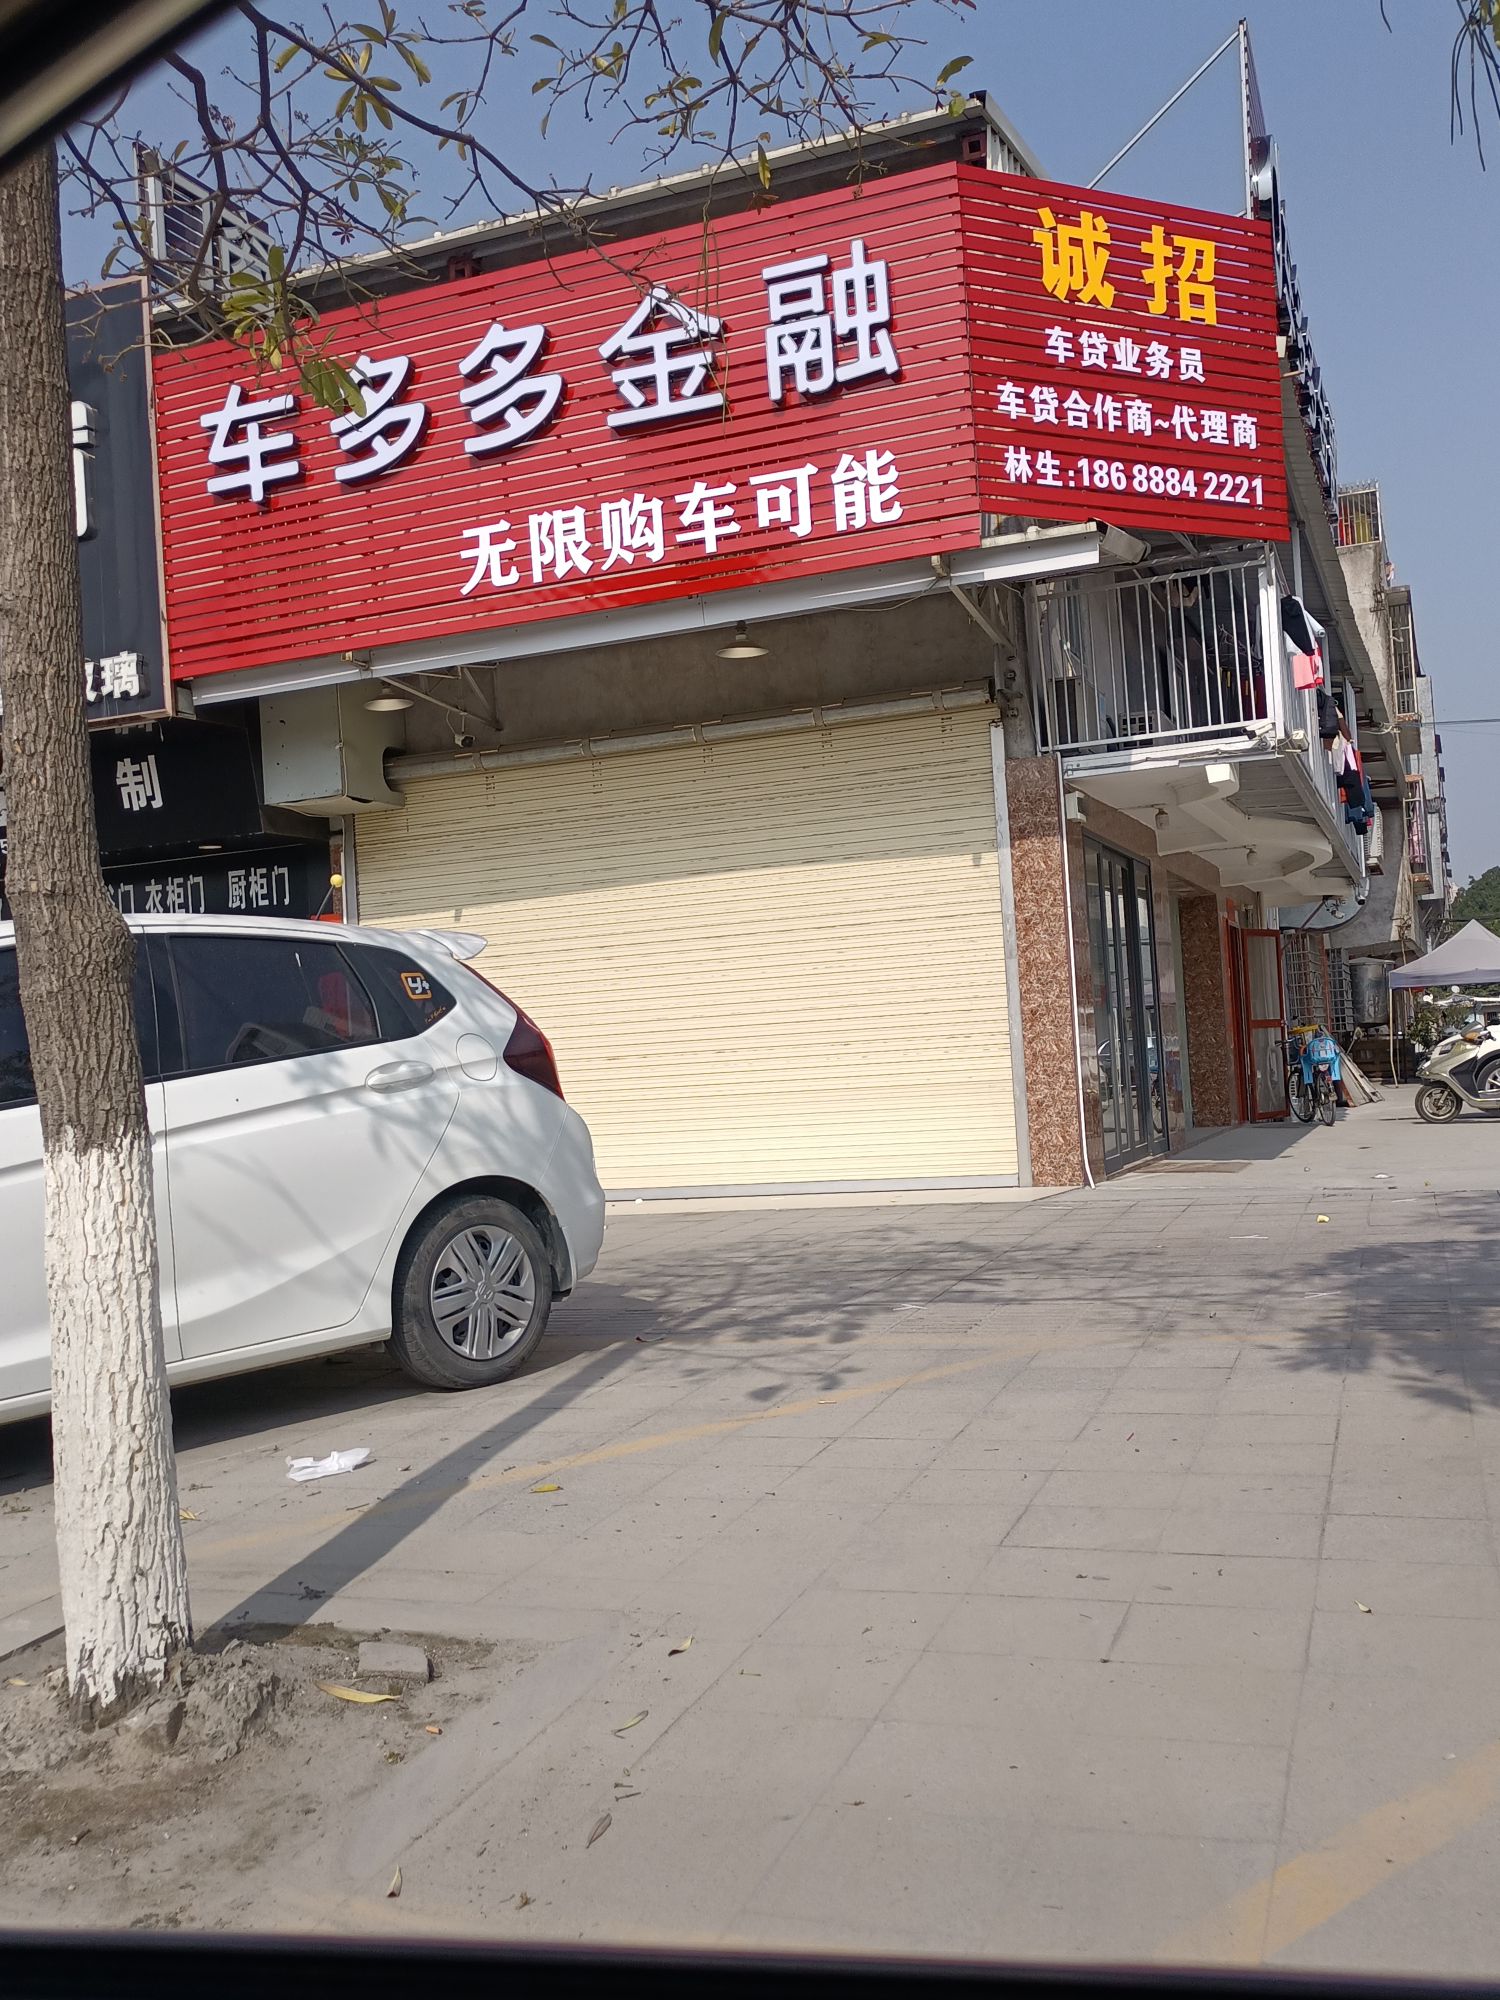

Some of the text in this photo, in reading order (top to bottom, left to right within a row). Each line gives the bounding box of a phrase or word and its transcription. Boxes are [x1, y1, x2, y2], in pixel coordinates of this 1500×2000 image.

[1033, 207, 1217, 326] 诚招
[200, 238, 899, 503] 车多多金融
[1045, 326, 1206, 383] 车贷业务员
[997, 382, 1257, 450] 车贷合作商~代理商
[1132, 464, 1197, 497] 8884
[1203, 472, 1263, 505] 2221
[459, 449, 904, 596] 无限购车可能
[116, 754, 164, 811] 制
[145, 874, 206, 914] 衣柜门
[228, 865, 290, 910] 厨柜门
